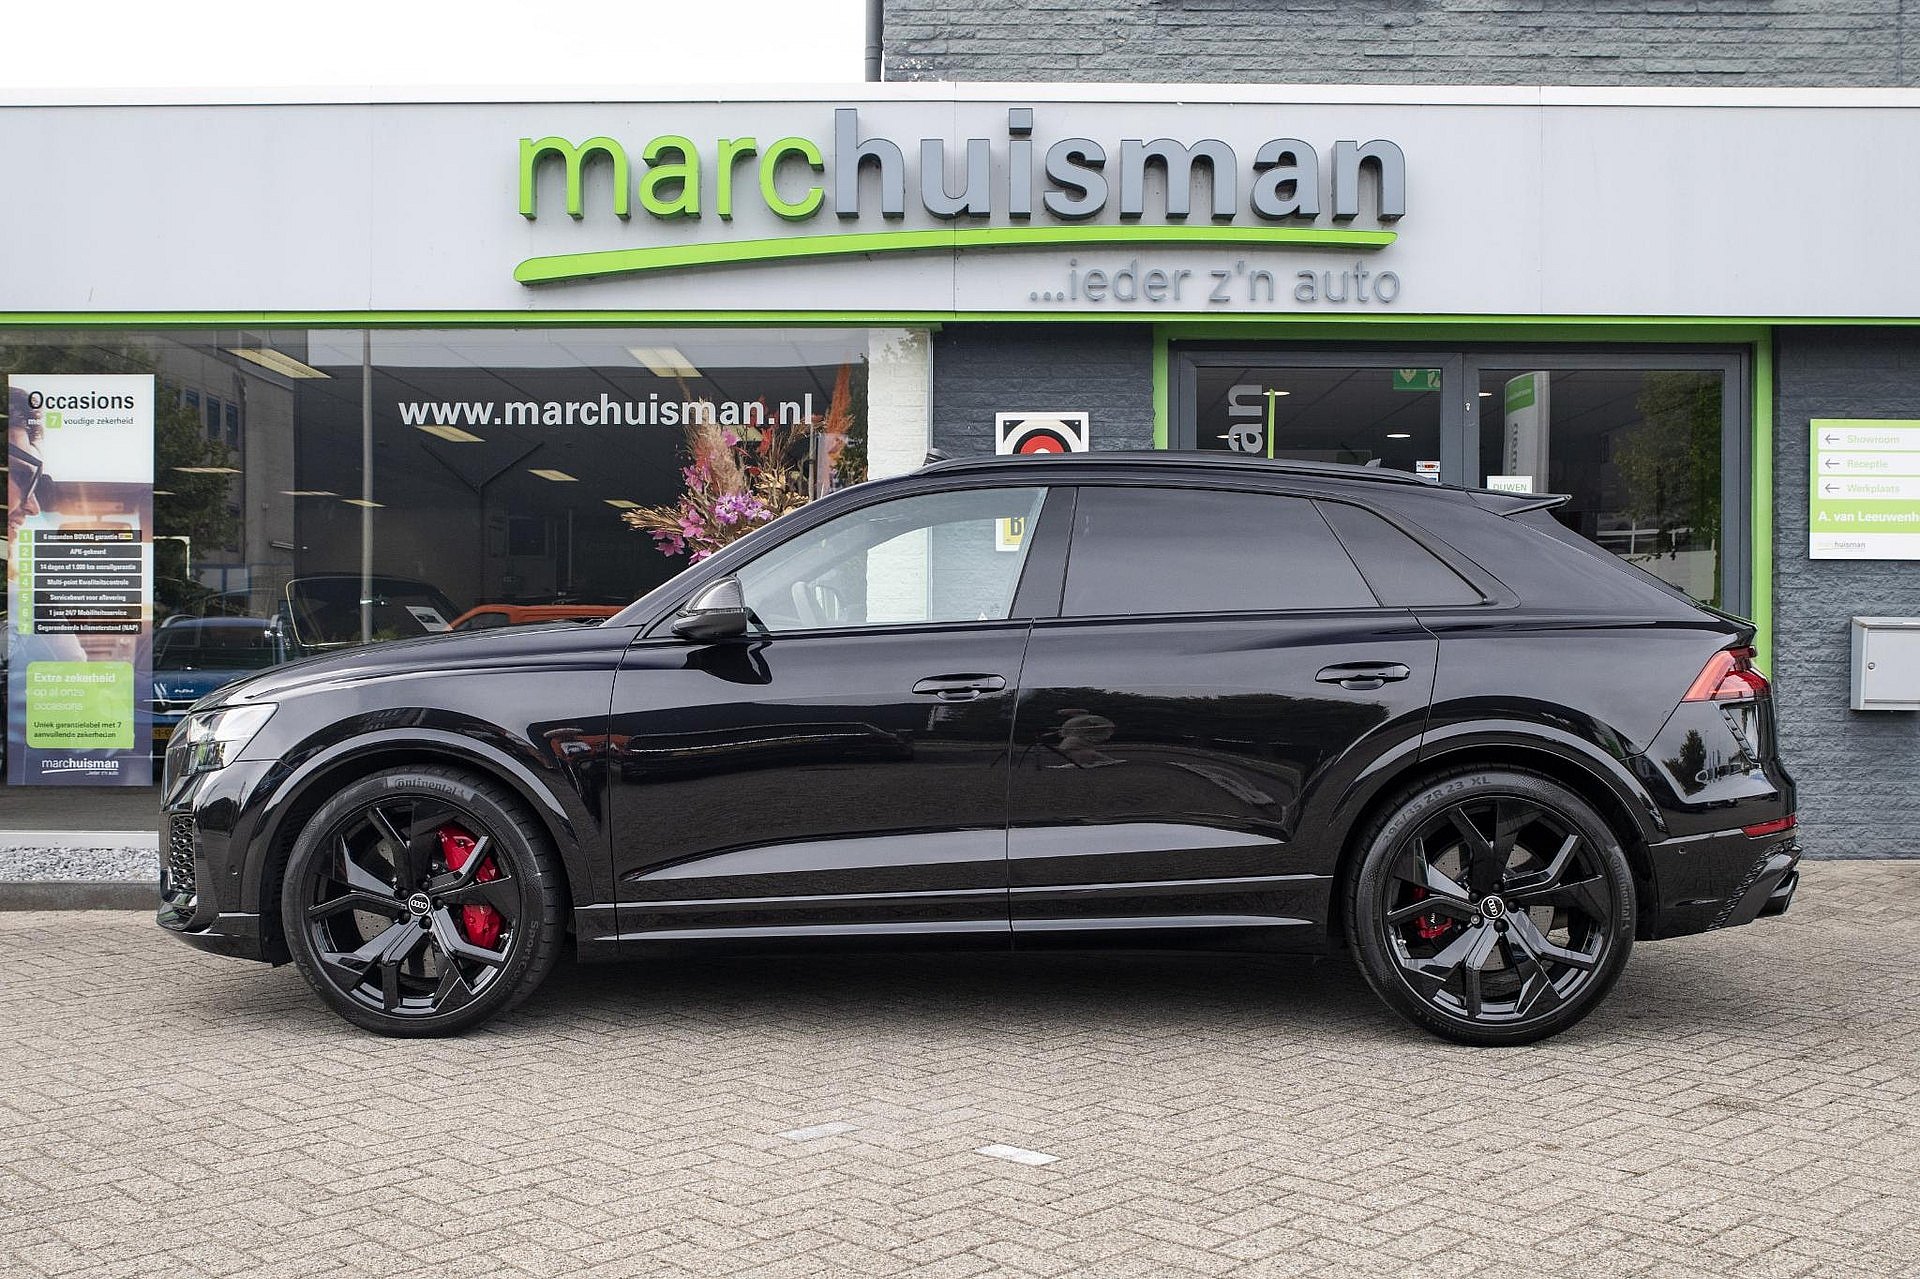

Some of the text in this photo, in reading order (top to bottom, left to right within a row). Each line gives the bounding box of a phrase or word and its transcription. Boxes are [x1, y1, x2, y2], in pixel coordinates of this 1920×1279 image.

[518, 108, 1406, 222] marchuisman
[1208, 259, 1275, 302] z'n
[1293, 264, 1401, 303] auto
[27, 391, 135, 410] Occasions
[398, 393, 813, 425] www.marchuisman.nl
[63, 416, 95, 426] voudige
[96, 416, 135, 425] zekerheid
[1847, 434, 1901, 444] Showroom
[1847, 459, 1889, 469] Receptie
[1847, 483, 1901, 494] Werkplaats
[1818, 511, 1831, 522] A.
[1833, 512, 1855, 522] van
[34, 672, 116, 683] Extra zekerheid
[33, 721, 54, 729] Uniek
[55, 721, 101, 730] garantielabel
[41, 758, 119, 768] marchuisman
[394, 778, 457, 796] Continental
[1446, 781, 1465, 793] 23
[1471, 775, 1492, 786] XL
